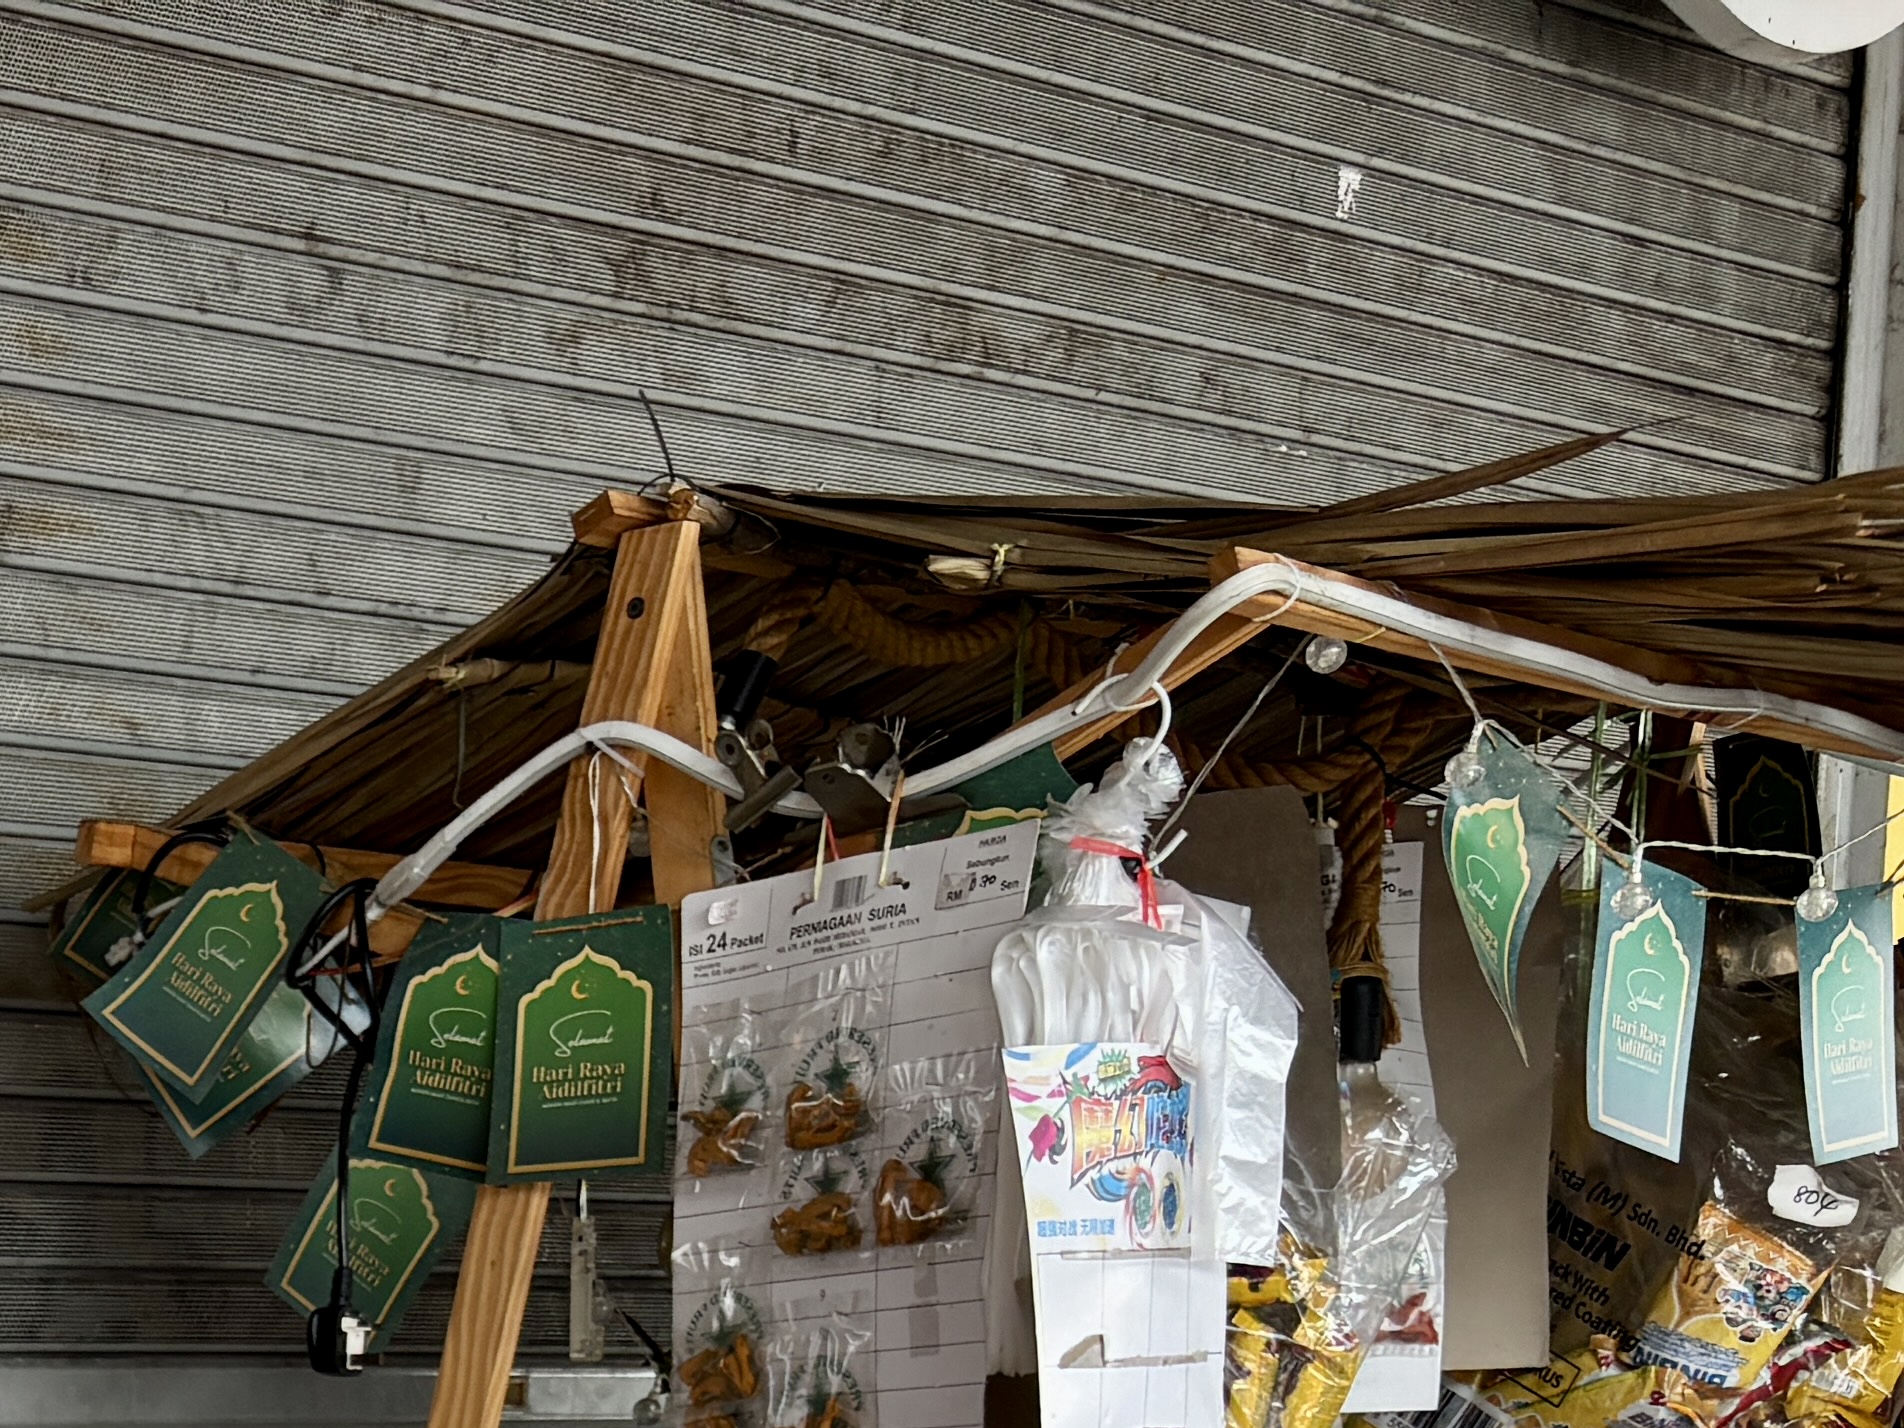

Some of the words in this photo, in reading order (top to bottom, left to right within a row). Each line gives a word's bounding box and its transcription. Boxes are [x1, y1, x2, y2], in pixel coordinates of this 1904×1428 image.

[868, 903, 907, 920] SURIA
[706, 932, 728, 954] 24
[729, 933, 764, 950] Packet
[408, 1049, 448, 1071] Hari
[450, 1057, 492, 1082] Raya
[532, 1065, 574, 1084] Hari
[578, 1060, 626, 1082] Raya
